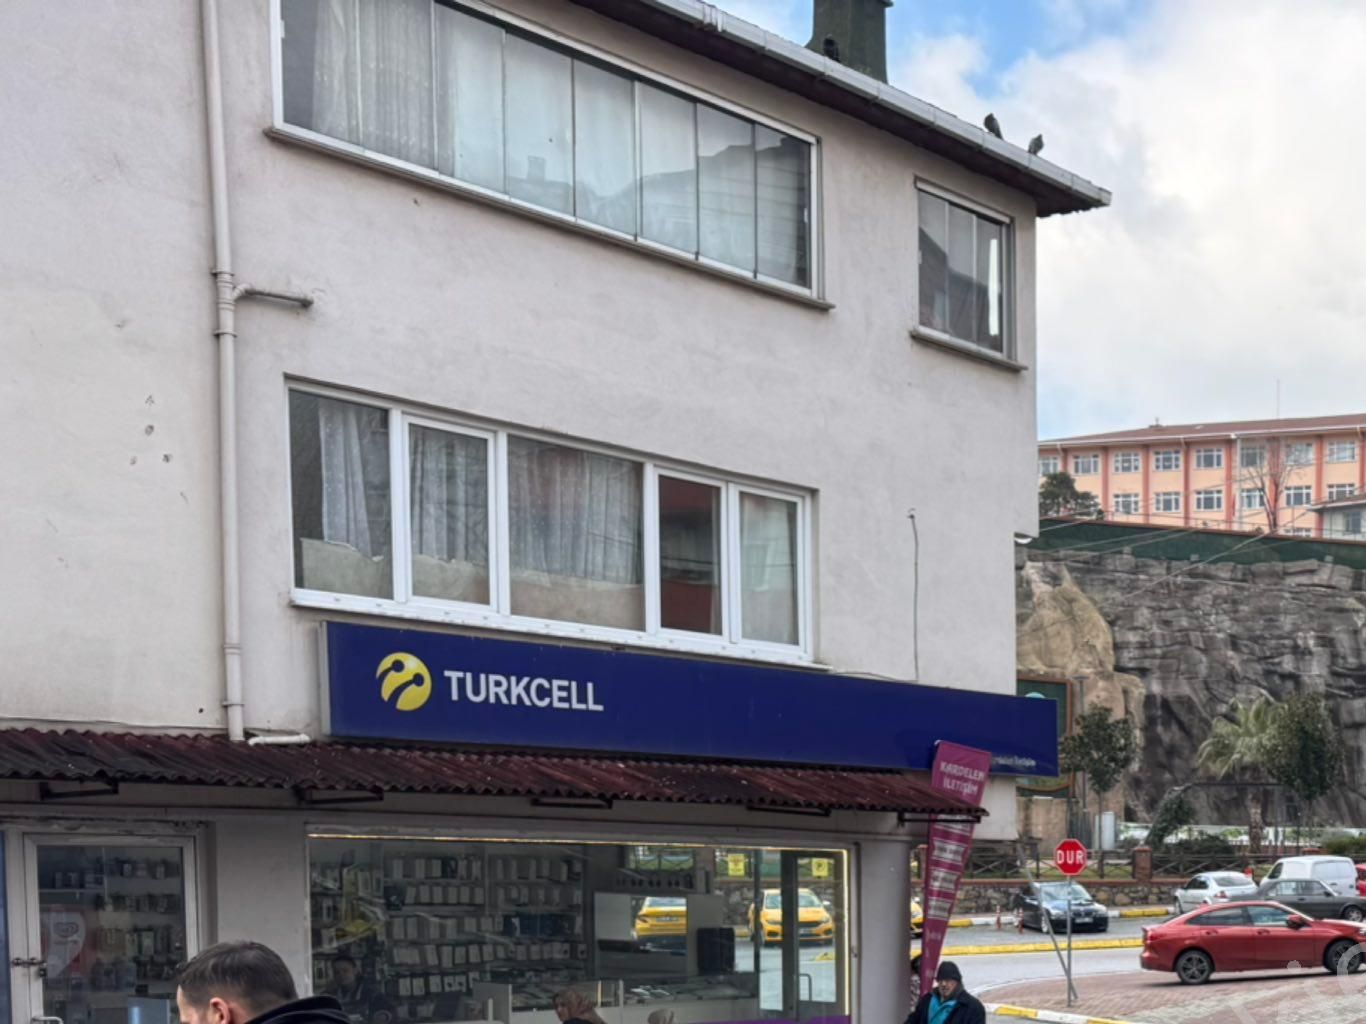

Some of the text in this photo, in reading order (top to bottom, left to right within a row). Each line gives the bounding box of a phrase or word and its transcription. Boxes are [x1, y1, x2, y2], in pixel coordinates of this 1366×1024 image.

[443, 669, 604, 711] TURKCELL
[940, 761, 985, 781] KARDELEN
[1057, 850, 1084, 865] DUR
